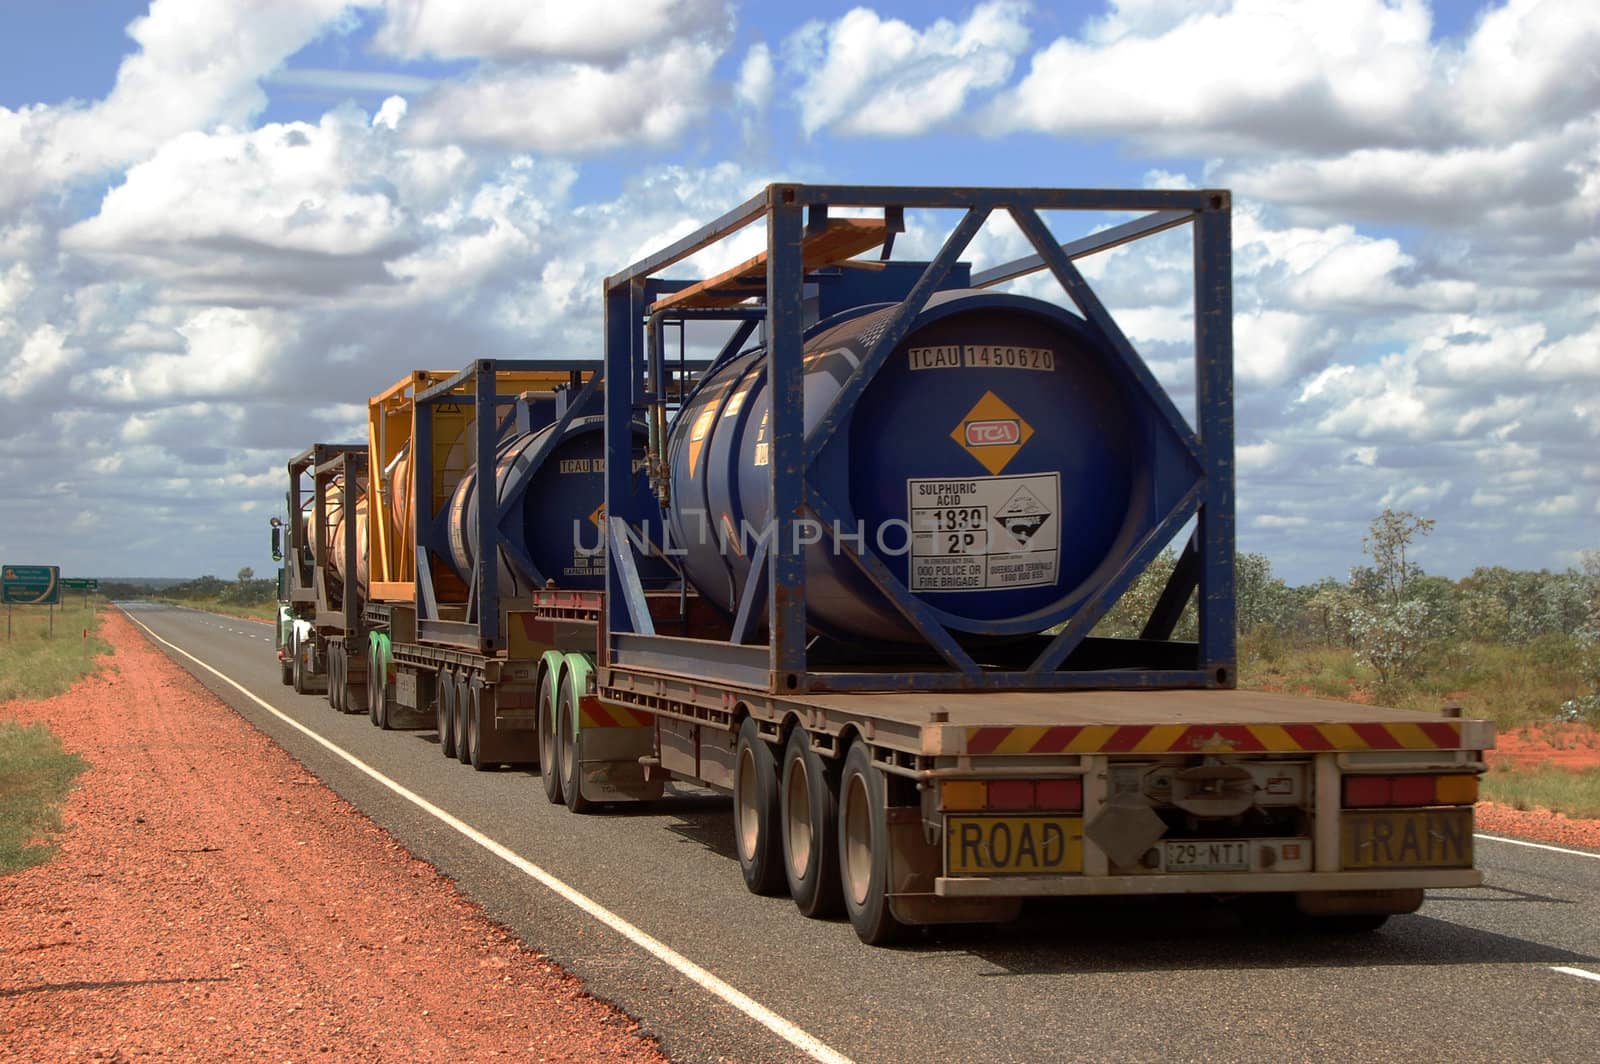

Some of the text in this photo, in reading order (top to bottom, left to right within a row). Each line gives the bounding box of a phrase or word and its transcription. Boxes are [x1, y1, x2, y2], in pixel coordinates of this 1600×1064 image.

[911, 347, 1051, 369] TCAU 1450620
[970, 425, 1012, 441] TCA
[561, 460, 589, 472] TCAU
[919, 483, 977, 495] SULPHURIC
[936, 495, 961, 506] ACID
[936, 565, 967, 576] POLICE
[969, 564, 982, 575] OR
[919, 576, 980, 587] FIRE BRIGADE
[960, 822, 1065, 868] ROAD
[1347, 816, 1466, 862] TRAIN
